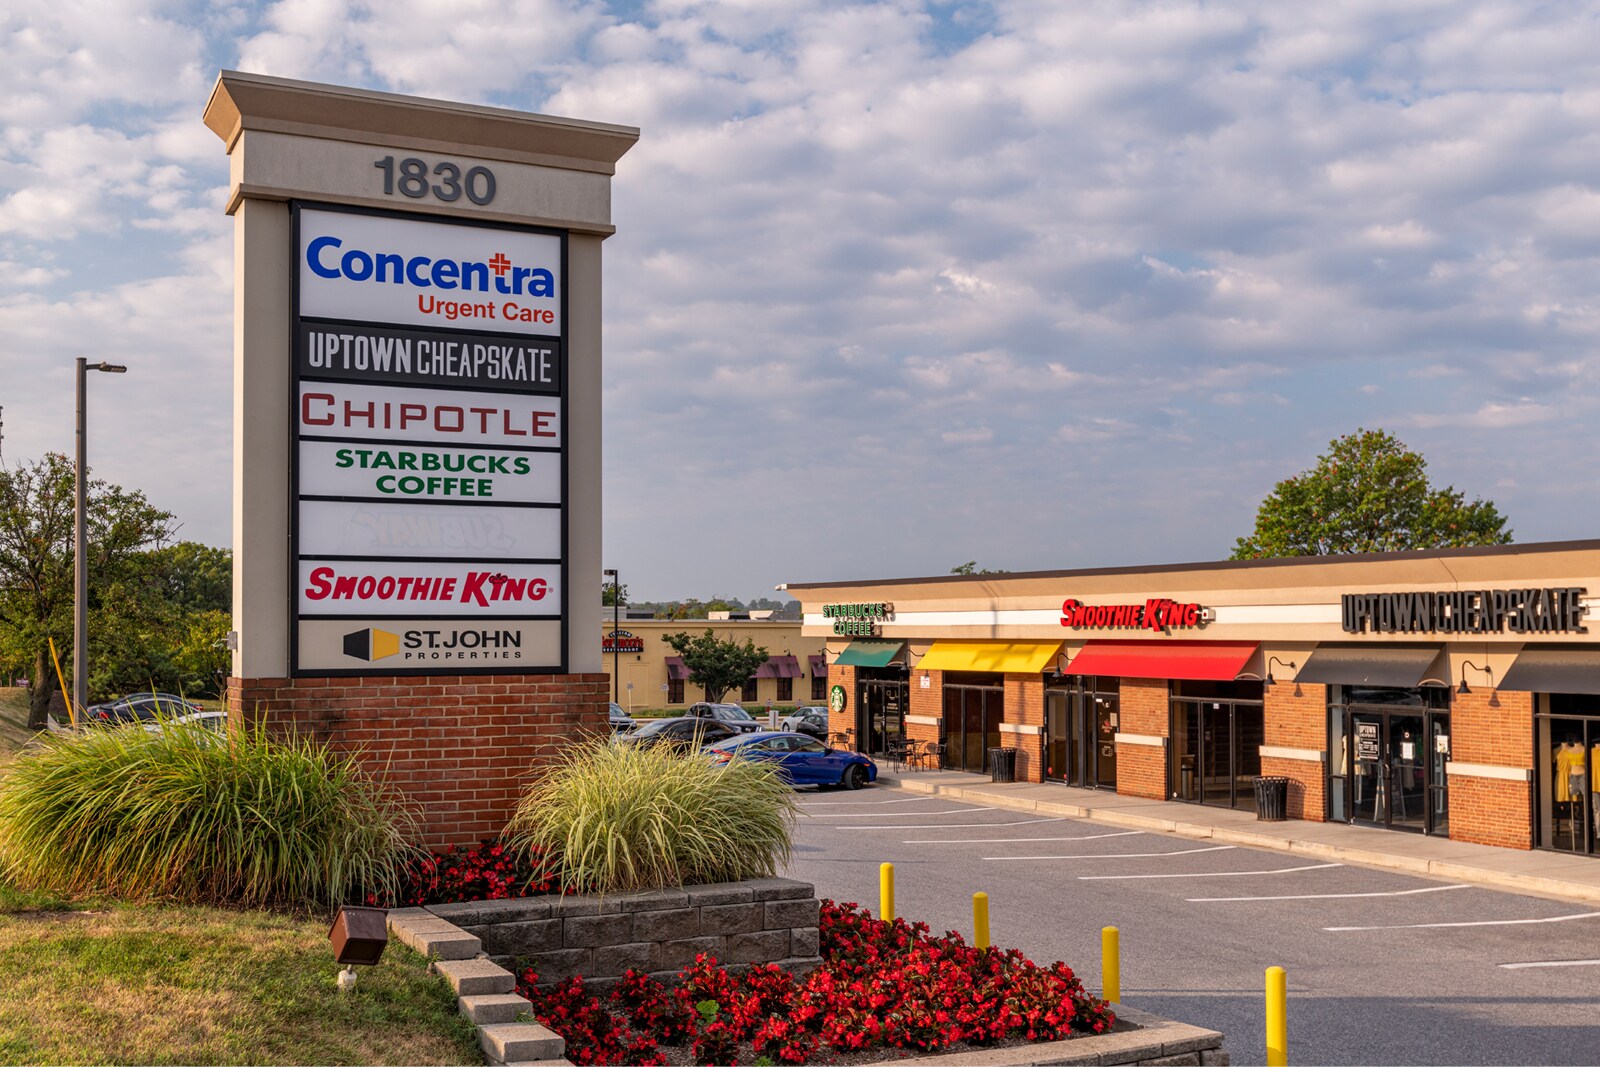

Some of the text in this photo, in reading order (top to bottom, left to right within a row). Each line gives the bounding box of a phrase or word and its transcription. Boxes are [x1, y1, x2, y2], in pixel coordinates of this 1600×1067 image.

[374, 155, 497, 206] 1830
[306, 236, 555, 298] Concentra
[418, 294, 555, 324] Urgent Care
[308, 331, 552, 383] UPTOWN CHEAPSKATE
[301, 392, 557, 438] CHIPOTLE
[335, 449, 531, 475] STARBUCKS
[375, 475, 493, 496] COFFEE
[305, 566, 458, 601] SMOOTHIE
[822, 603, 883, 618] STARBUCKS
[1060, 599, 1140, 627] SMOOTHIE
[1341, 587, 1588, 632] UPTOWN CHEAPSKATE
[833, 621, 871, 636] COFFEE
[404, 651, 522, 660] PROPERTIES
